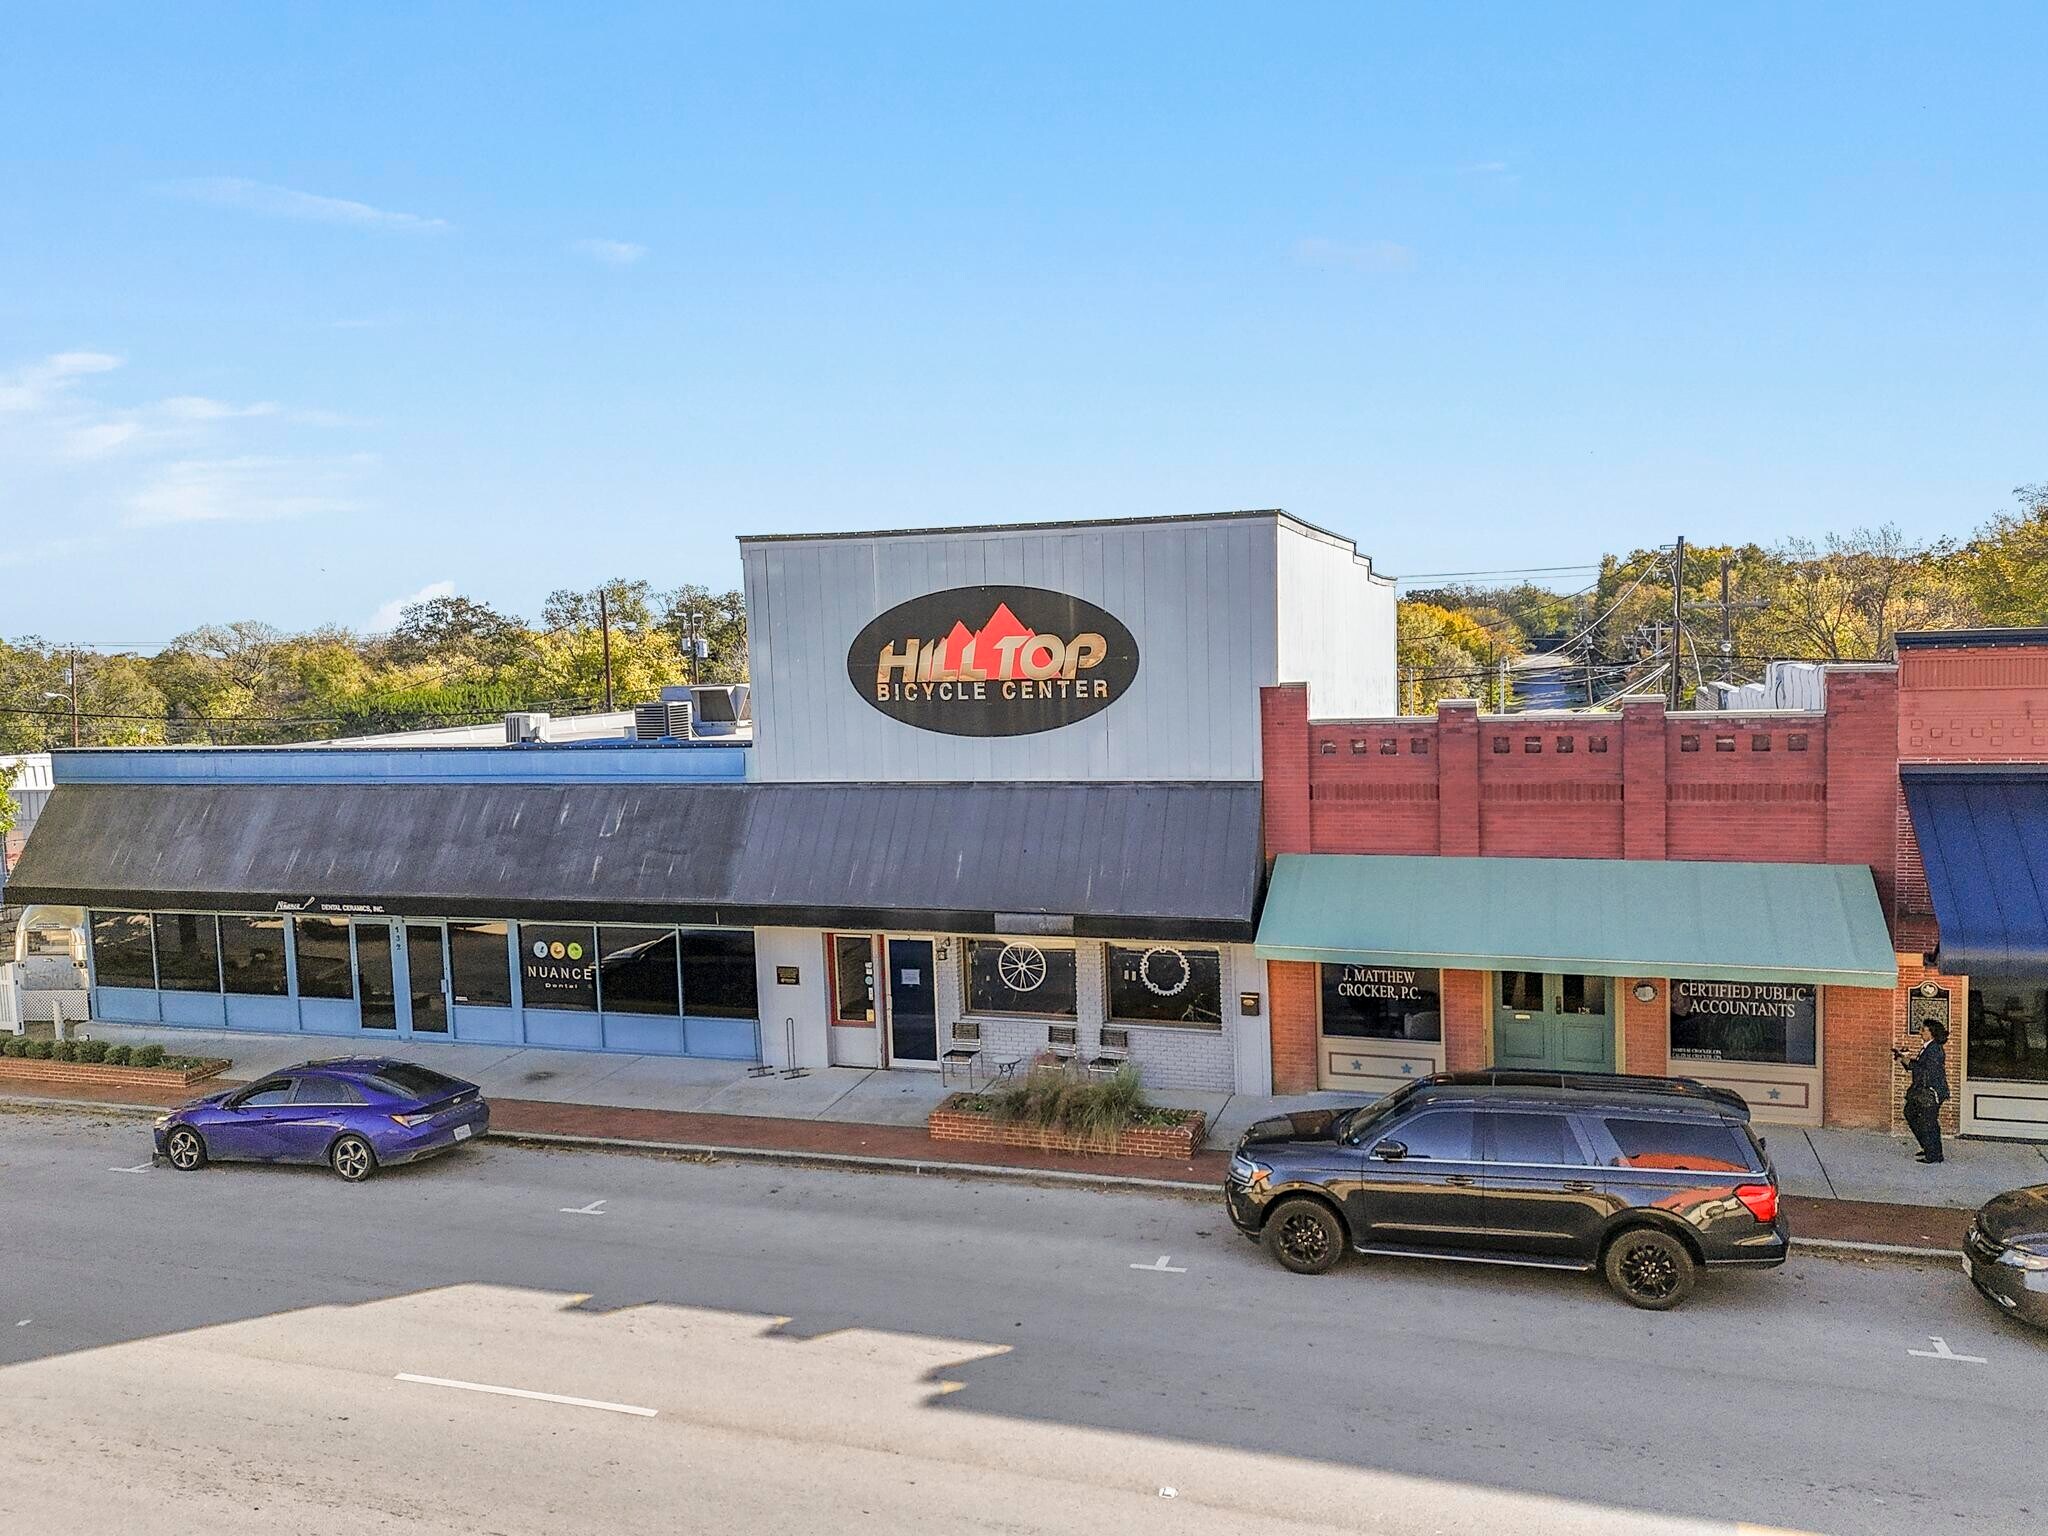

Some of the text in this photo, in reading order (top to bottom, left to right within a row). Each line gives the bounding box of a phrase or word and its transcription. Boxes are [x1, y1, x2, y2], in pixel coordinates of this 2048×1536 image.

[877, 680, 1109, 701] BICYCLE CENTER
[527, 965, 593, 980] NUANCE
[1343, 968, 1415, 984] J. MATTHEW
[1338, 983, 1422, 1000] CROCKER, P.C.
[1679, 982, 1807, 1001] CERTIFIED PUBLIC
[1690, 1000, 1796, 1018] ACCOUNTANTS
